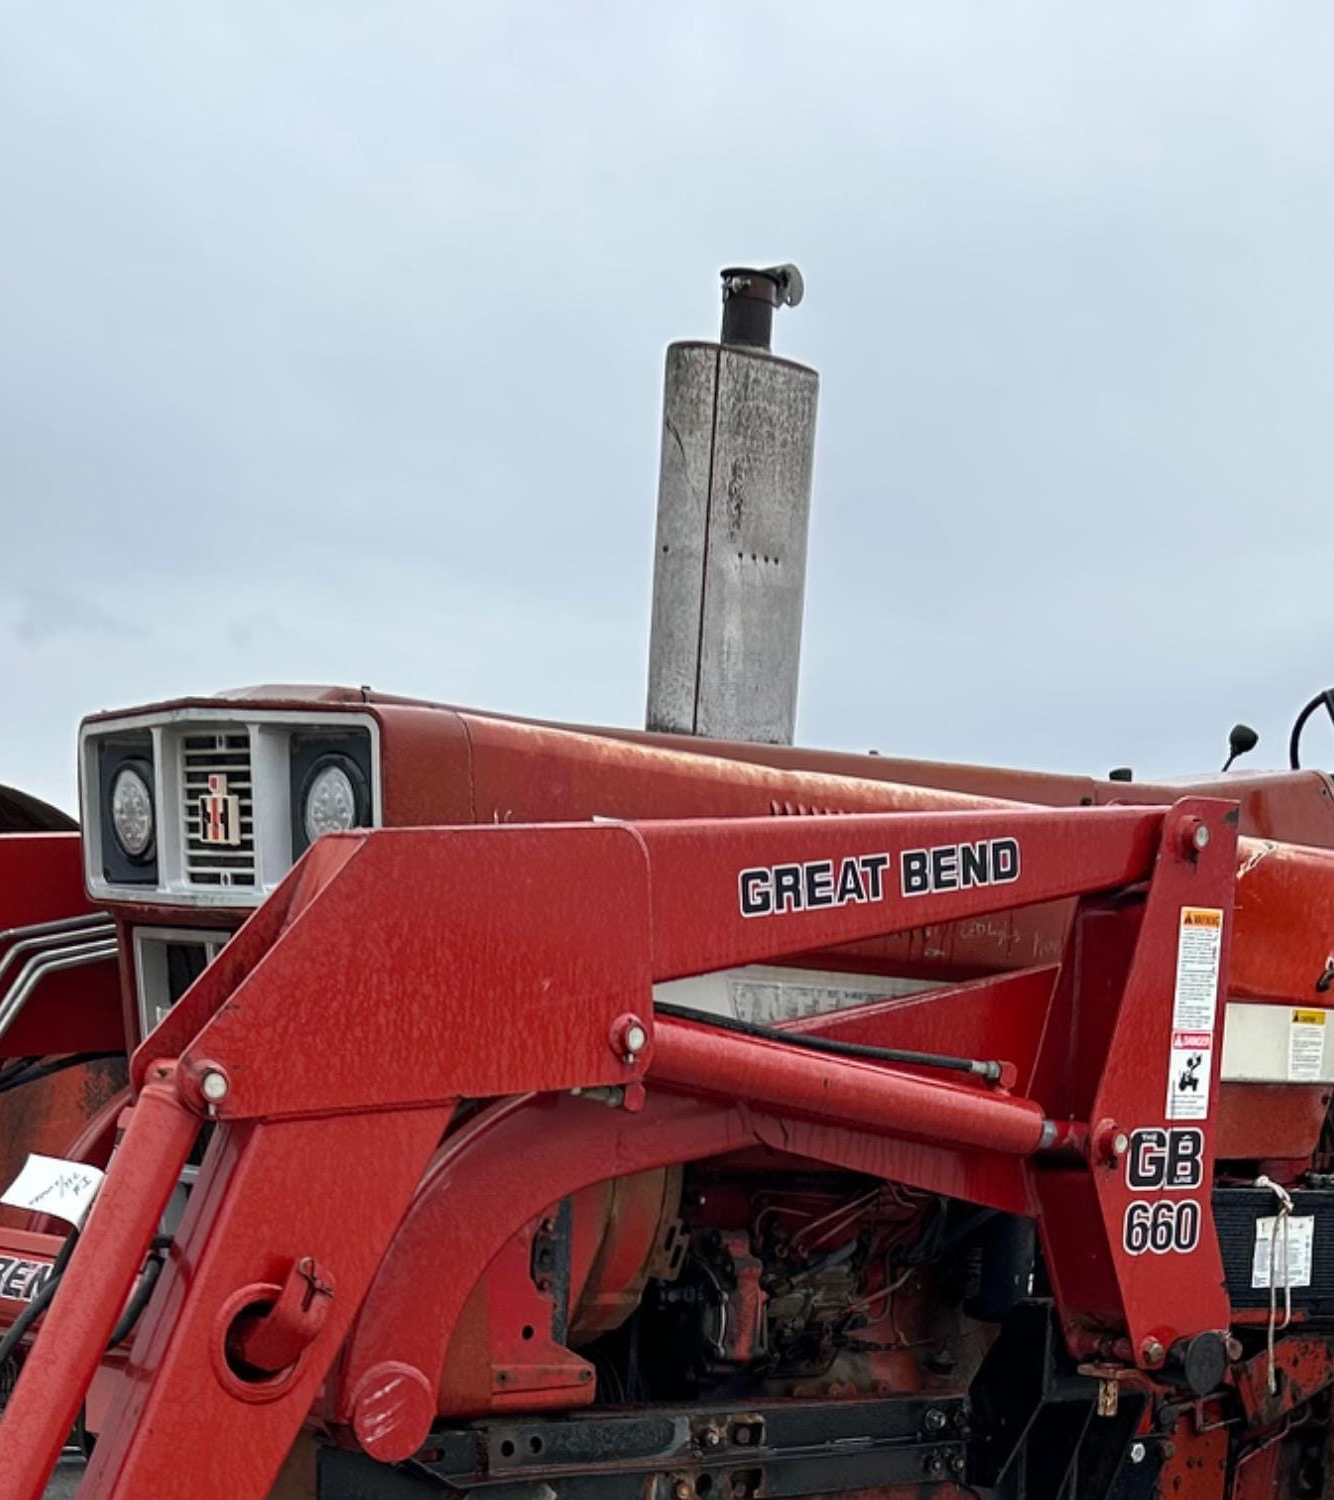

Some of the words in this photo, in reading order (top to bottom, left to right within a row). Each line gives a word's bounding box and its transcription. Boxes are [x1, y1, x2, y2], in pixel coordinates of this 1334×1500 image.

[739, 852, 890, 918] GREAT
[900, 837, 1020, 897] BEND
[1126, 1127, 1204, 1190] GB
[1123, 1199, 1201, 1256] 660
